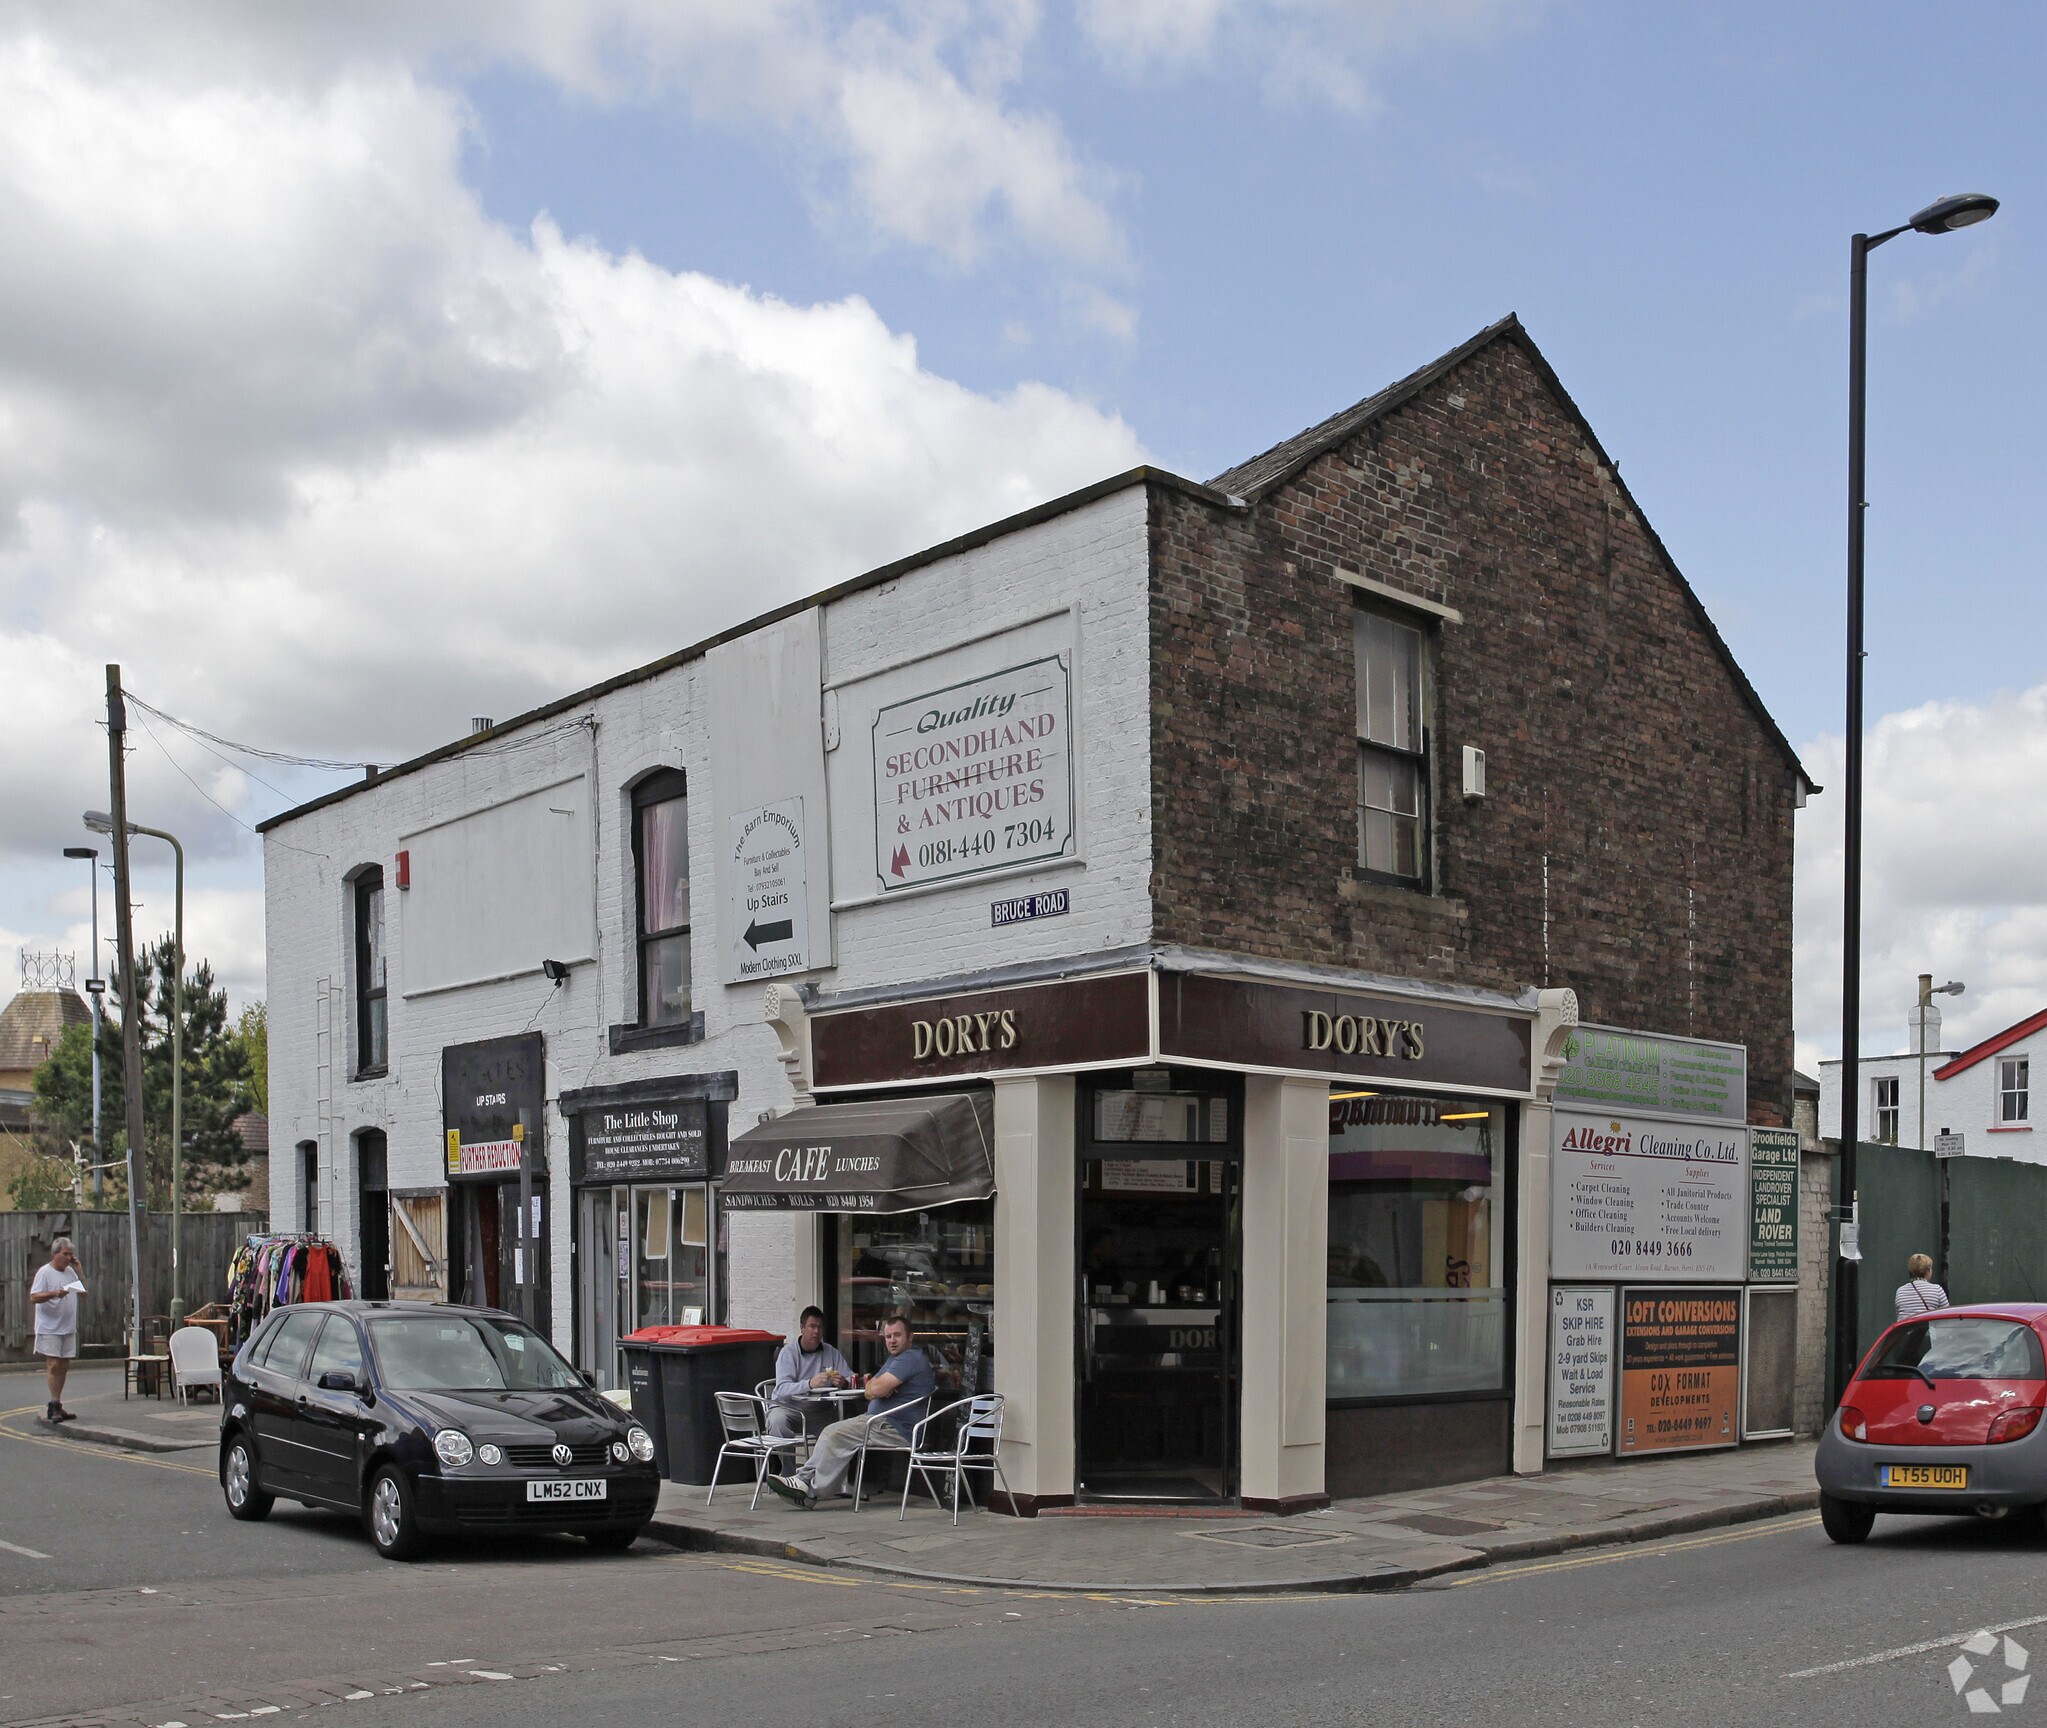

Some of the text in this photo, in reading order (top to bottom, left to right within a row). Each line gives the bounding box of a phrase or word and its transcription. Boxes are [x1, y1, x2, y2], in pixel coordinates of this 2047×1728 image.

[917, 693, 1017, 734] Quality
[886, 713, 1055, 778] SECONDHAND
[897, 748, 1042, 804] FURNITURE
[897, 779, 1044, 834] & ANTIQUES
[735, 810, 800, 863] The Barn Emporium
[919, 816, 1055, 867] 0181-440 7304
[766, 847, 790, 860] Collectables
[762, 864, 771, 874] And
[747, 892, 788, 912] Up Stairs
[994, 892, 1065, 922] BRUCE ROAD
[740, 959, 762, 975] Modern
[762, 955, 787, 971] Clothing
[912, 1009, 1017, 1060] DORY'S
[1309, 1010, 1425, 1060] DORY'S
[1583, 1031, 1660, 1065] PLATINUM
[1587, 1069, 1621, 1090] 8368
[1625, 1075, 1660, 1095] 4545
[476, 1093, 506, 1106] UP STAIRS
[604, 1111, 678, 1129] The Little Shop
[688, 1130, 702, 1138] SOLD
[1752, 1131, 1796, 1146] Brookfields
[1562, 1127, 1739, 1161] Allegri Cleaning Co. Ltd.
[462, 1146, 486, 1170] FURTHER
[1752, 1146, 1796, 1164] Garage Ltd
[729, 1146, 880, 1182] BREAKFAST CAFE LUNCHES
[1590, 1160, 1616, 1171] Services
[1685, 1167, 1710, 1178] Supplies
[1753, 1170, 1794, 1181] INDEPENDENT
[1576, 1182, 1630, 1195] Carpet Cleaning
[1666, 1187, 1732, 1200] All Janitorial Products
[1755, 1182, 1792, 1194] LANDROVER
[725, 1195, 777, 1207] SANDWICHES
[789, 1195, 815, 1207] ROLLS
[826, 1195, 840, 1207] 020
[859, 1195, 874, 1207] 1954
[1576, 1195, 1634, 1208] Window Cleaning
[1666, 1200, 1709, 1211] Trade Counter
[1756, 1194, 1790, 1205] SPECIALIST
[1575, 1209, 1628, 1221] Office Cleaning
[1666, 1213, 1720, 1224] Accounts Welcome
[1755, 1208, 1781, 1223] LAND
[1575, 1222, 1635, 1234] Builders Cleaning
[1666, 1226, 1721, 1238] Free Local delivery
[1759, 1224, 1792, 1240] ROVER
[1611, 1240, 1692, 1256] 020 8449 3666
[1760, 1269, 1770, 1277] 020
[1576, 1298, 1594, 1312] KSR
[1626, 1300, 1736, 1323] LOFT CONVERSIONS
[1562, 1317, 1604, 1331] SKIP HIRE
[1626, 1324, 1735, 1337] EXTENSIONS AND GARAGE CONVERSIONS
[1566, 1334, 1602, 1347] Grab Hire
[1558, 1352, 1608, 1366] 2-9 yard Skips
[1561, 1368, 1603, 1381] Wait & Load
[1569, 1383, 1596, 1395] Service
[1651, 1372, 1711, 1395] COX FORMAT
[1558, 1398, 1590, 1408] Reasonable
[1651, 1394, 1710, 1407] DEVELOPMENTS
[1557, 1413, 1566, 1422] Tel
[1583, 1411, 1592, 1420] 449
[1556, 1425, 1569, 1434] Mob
[1891, 1467, 1930, 1483] LT55
[533, 1481, 602, 1498] LM52 CNX
